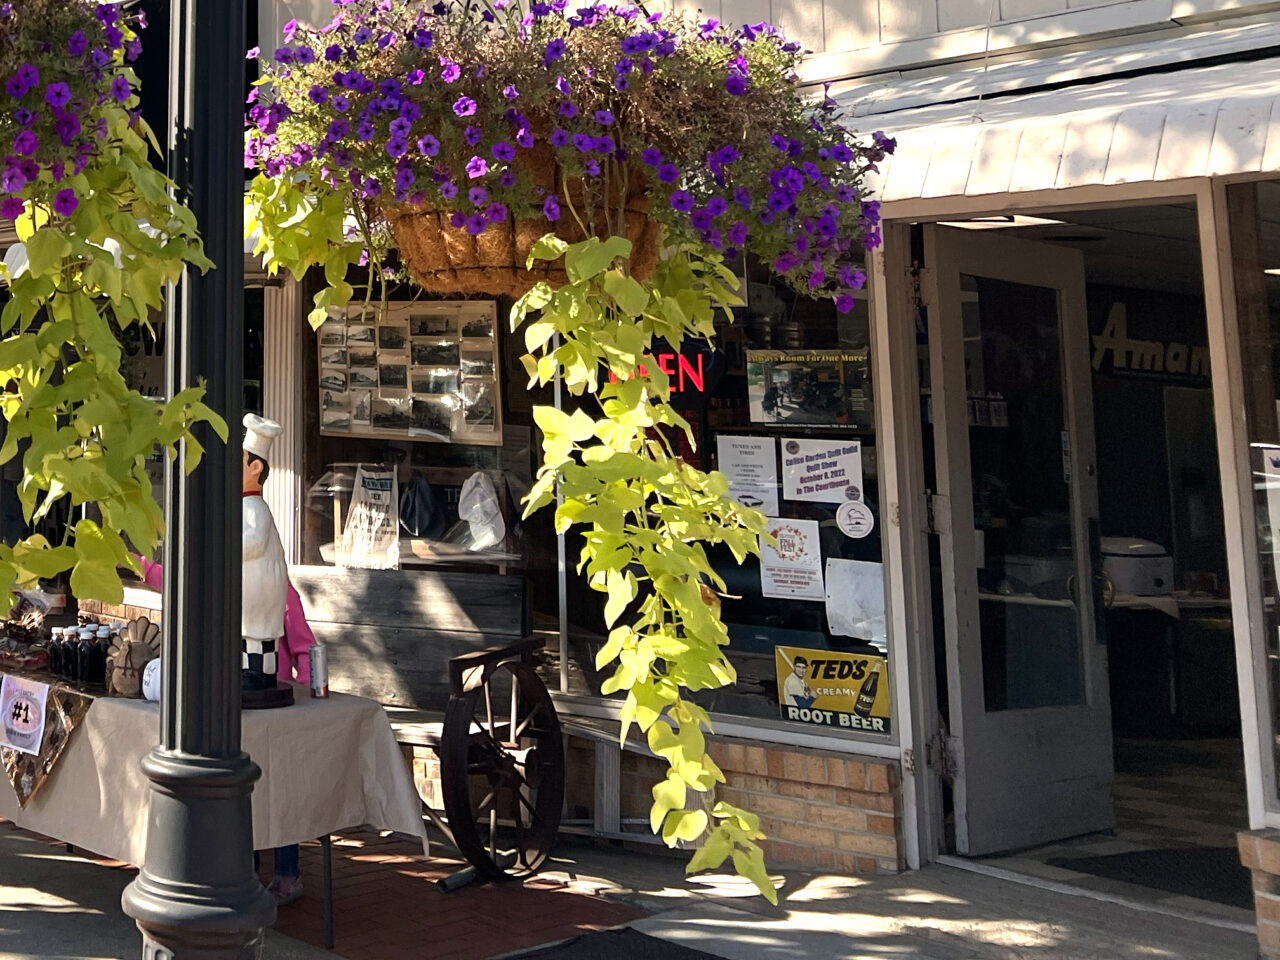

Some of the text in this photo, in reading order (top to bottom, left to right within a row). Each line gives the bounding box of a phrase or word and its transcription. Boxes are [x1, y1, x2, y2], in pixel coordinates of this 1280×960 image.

[780, 354, 805, 362] Room
[806, 354, 821, 362] For
[821, 354, 839, 362] One
[840, 354, 863, 362] More
[607, 352, 704, 392] EN
[827, 449, 841, 458] Quilt
[806, 461, 837, 473] Quilt Show
[800, 473, 823, 484] October
[830, 468, 845, 478] 2022
[803, 486, 814, 494] The
[815, 479, 850, 492] Courthouse
[810, 659, 869, 680] TED'S
[816, 687, 857, 697] CREAMY
[12, 701, 30, 724] #1
[787, 706, 885, 732] ROOT BEER
